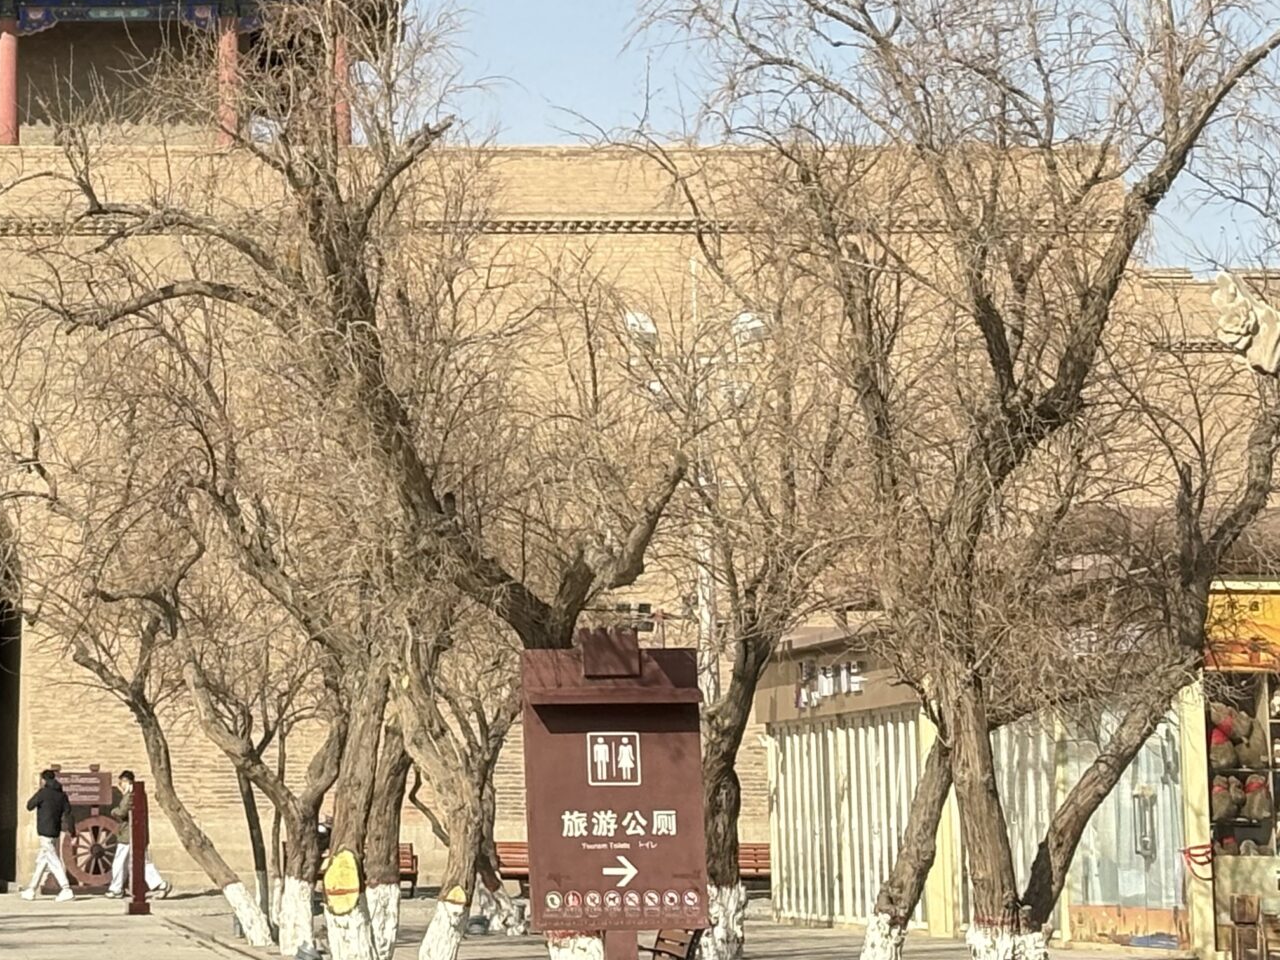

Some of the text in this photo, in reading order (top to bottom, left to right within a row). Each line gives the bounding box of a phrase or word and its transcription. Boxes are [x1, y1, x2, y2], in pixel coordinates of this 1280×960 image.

[561, 810, 677, 837] 旅游公厕
[638, 841, 658, 849] トイレ
